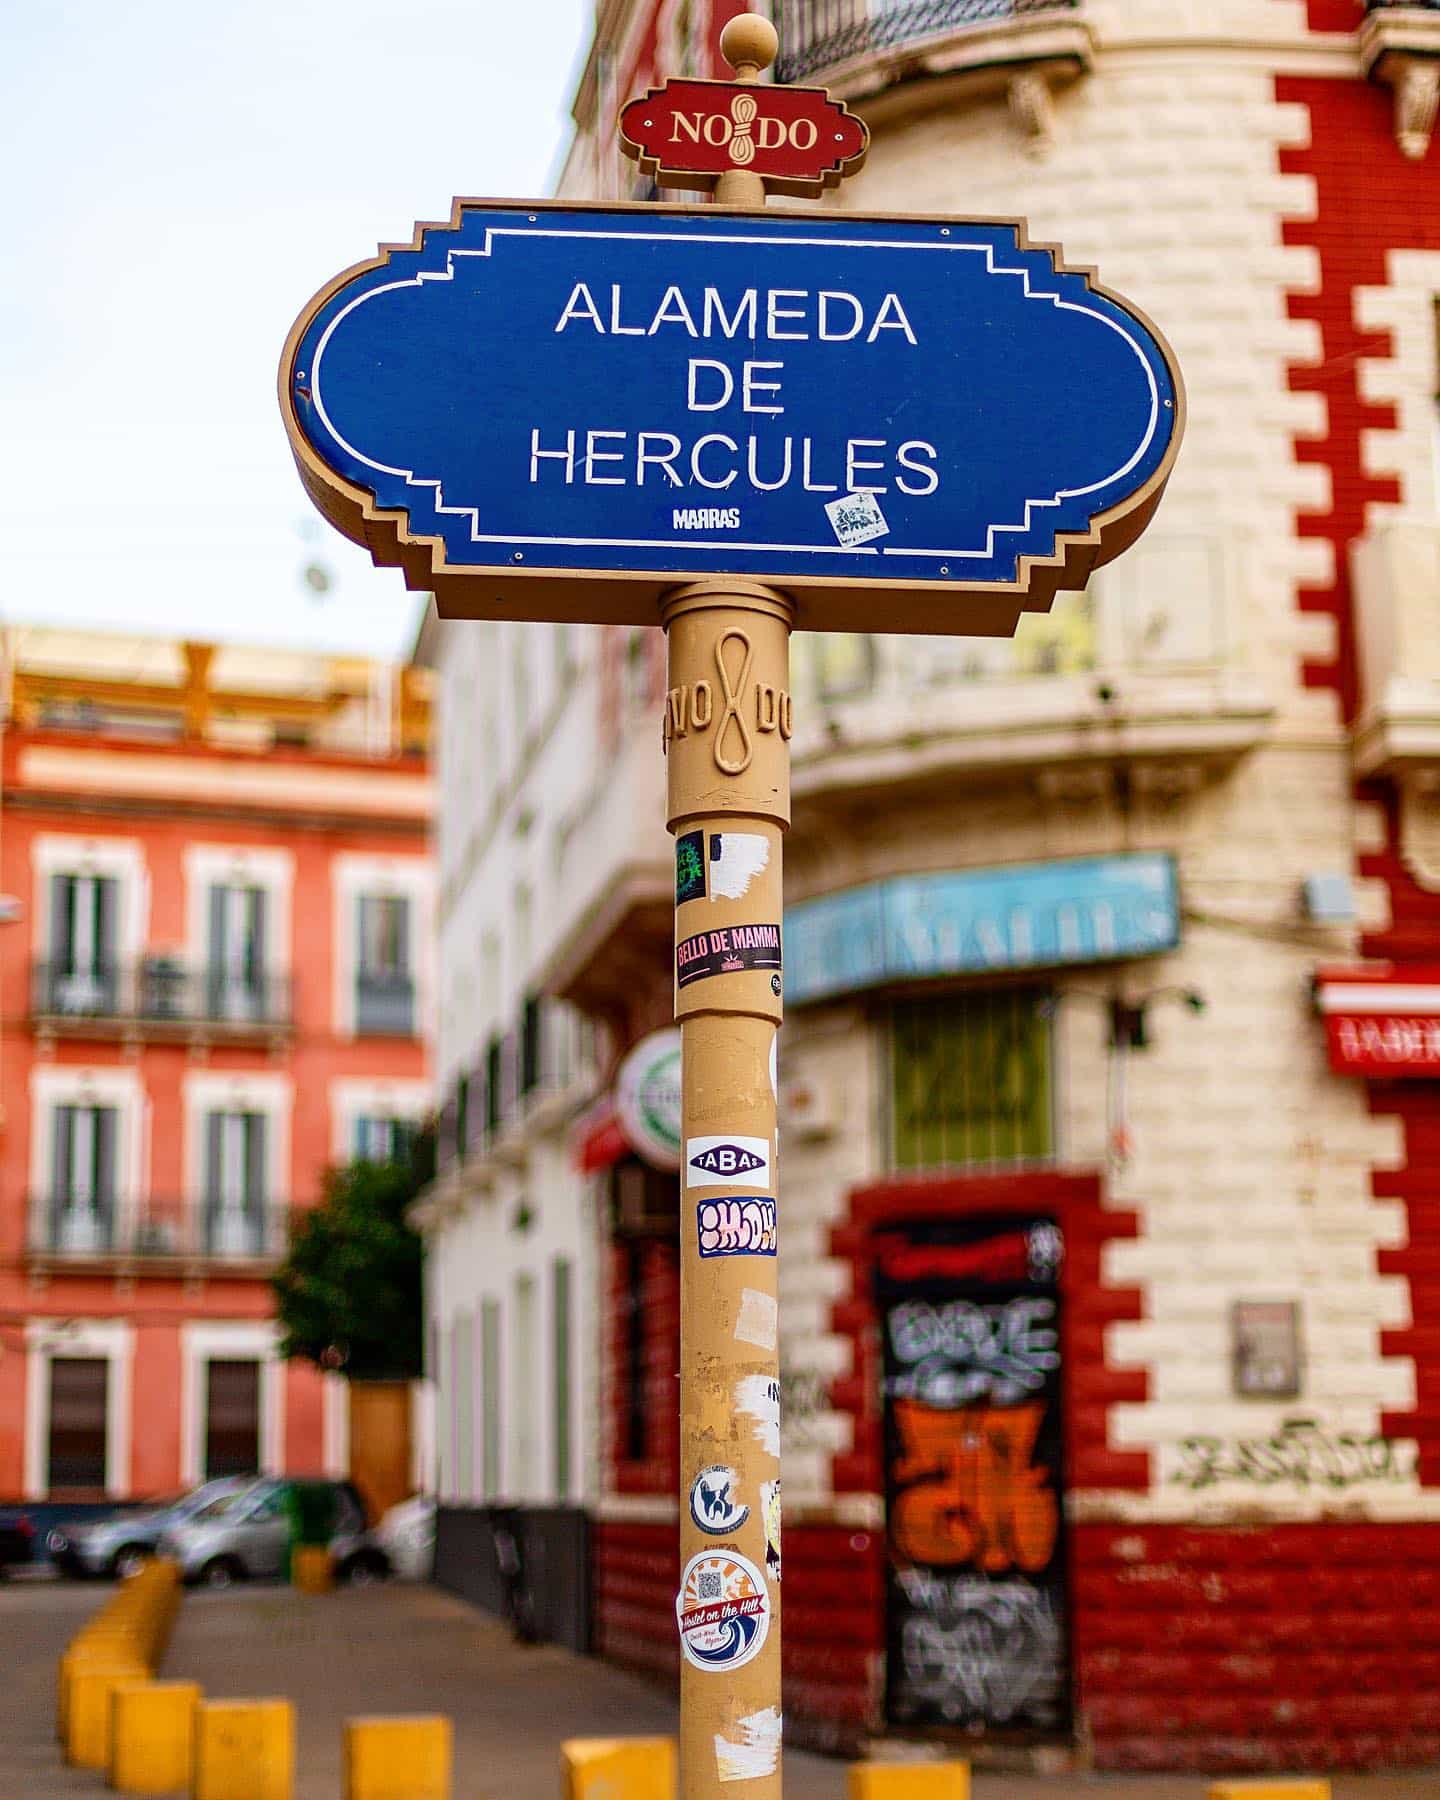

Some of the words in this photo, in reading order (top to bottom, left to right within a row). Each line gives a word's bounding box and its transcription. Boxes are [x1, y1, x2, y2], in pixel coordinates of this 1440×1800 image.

[668, 111, 733, 146] NO
[755, 117, 818, 150] DO
[555, 282, 918, 345] ALAMEDA
[687, 358, 785, 414] DE
[529, 428, 939, 496] HERCULES
[672, 507, 740, 530] MARRAS
[677, 932, 708, 967] BELLO
[711, 929, 731, 954] DE
[731, 926, 779, 950] MAMMA
[698, 1150, 758, 1171] TABAS
[706, 1611, 720, 1622] on
[721, 1603, 738, 1618] the
[739, 1598, 759, 1614] Hill
